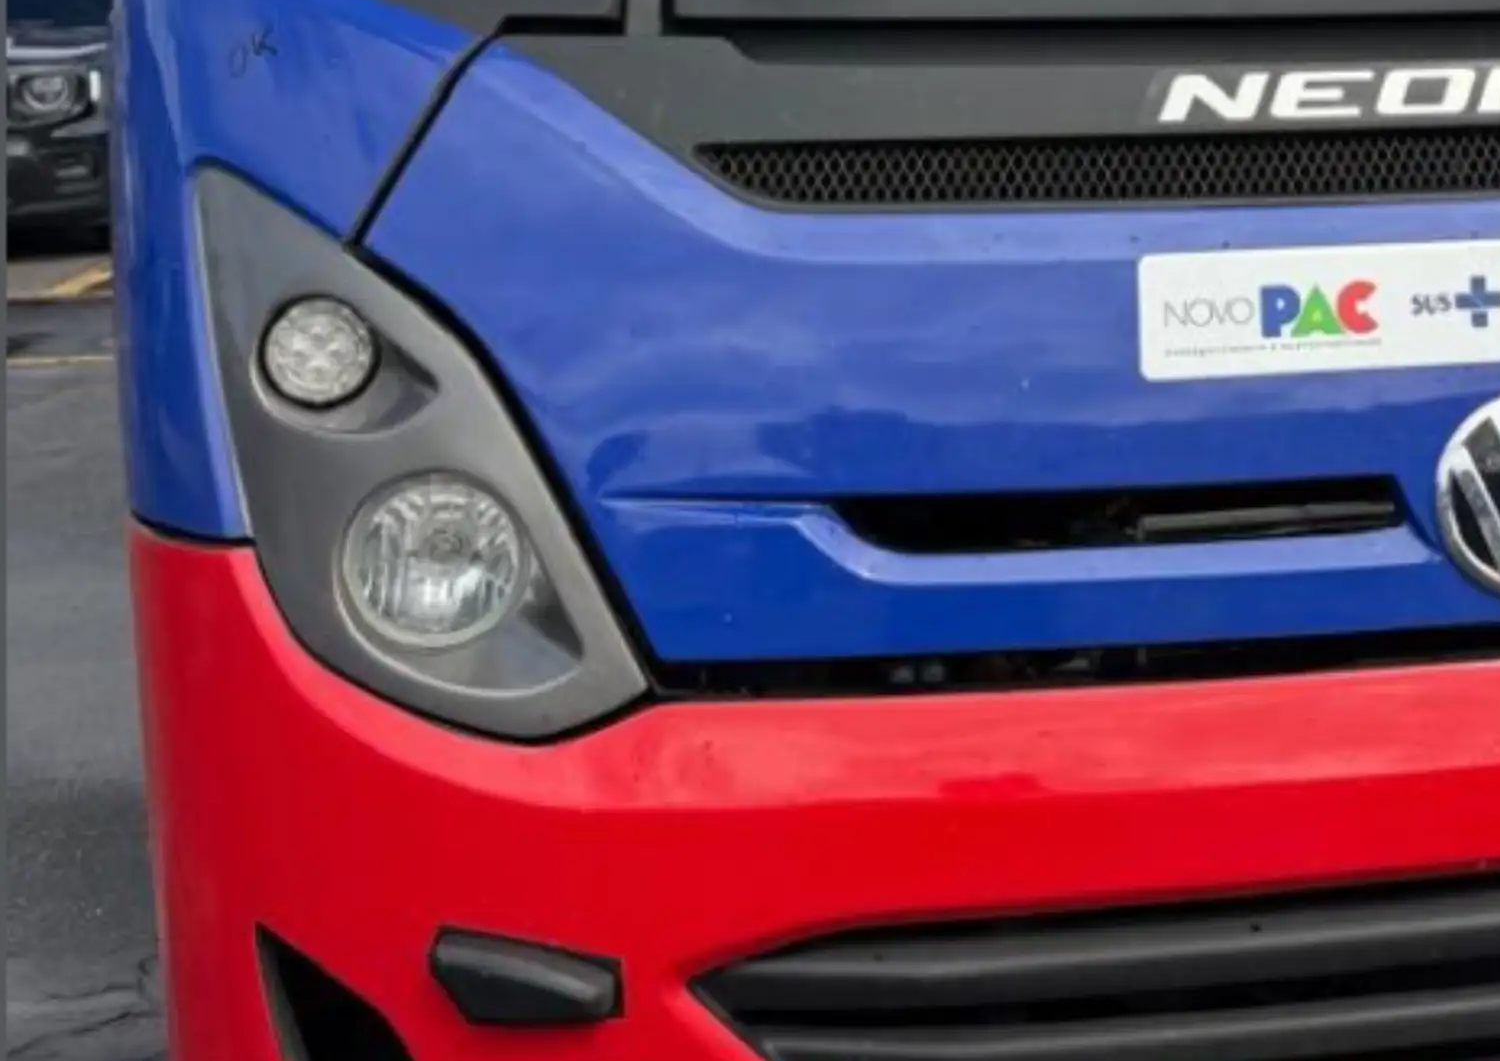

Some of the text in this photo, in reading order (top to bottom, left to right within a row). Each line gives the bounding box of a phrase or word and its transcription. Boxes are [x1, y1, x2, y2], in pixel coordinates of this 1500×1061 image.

[1162, 280, 1379, 339] NOVO PAC
[1410, 292, 1451, 316] SUS
